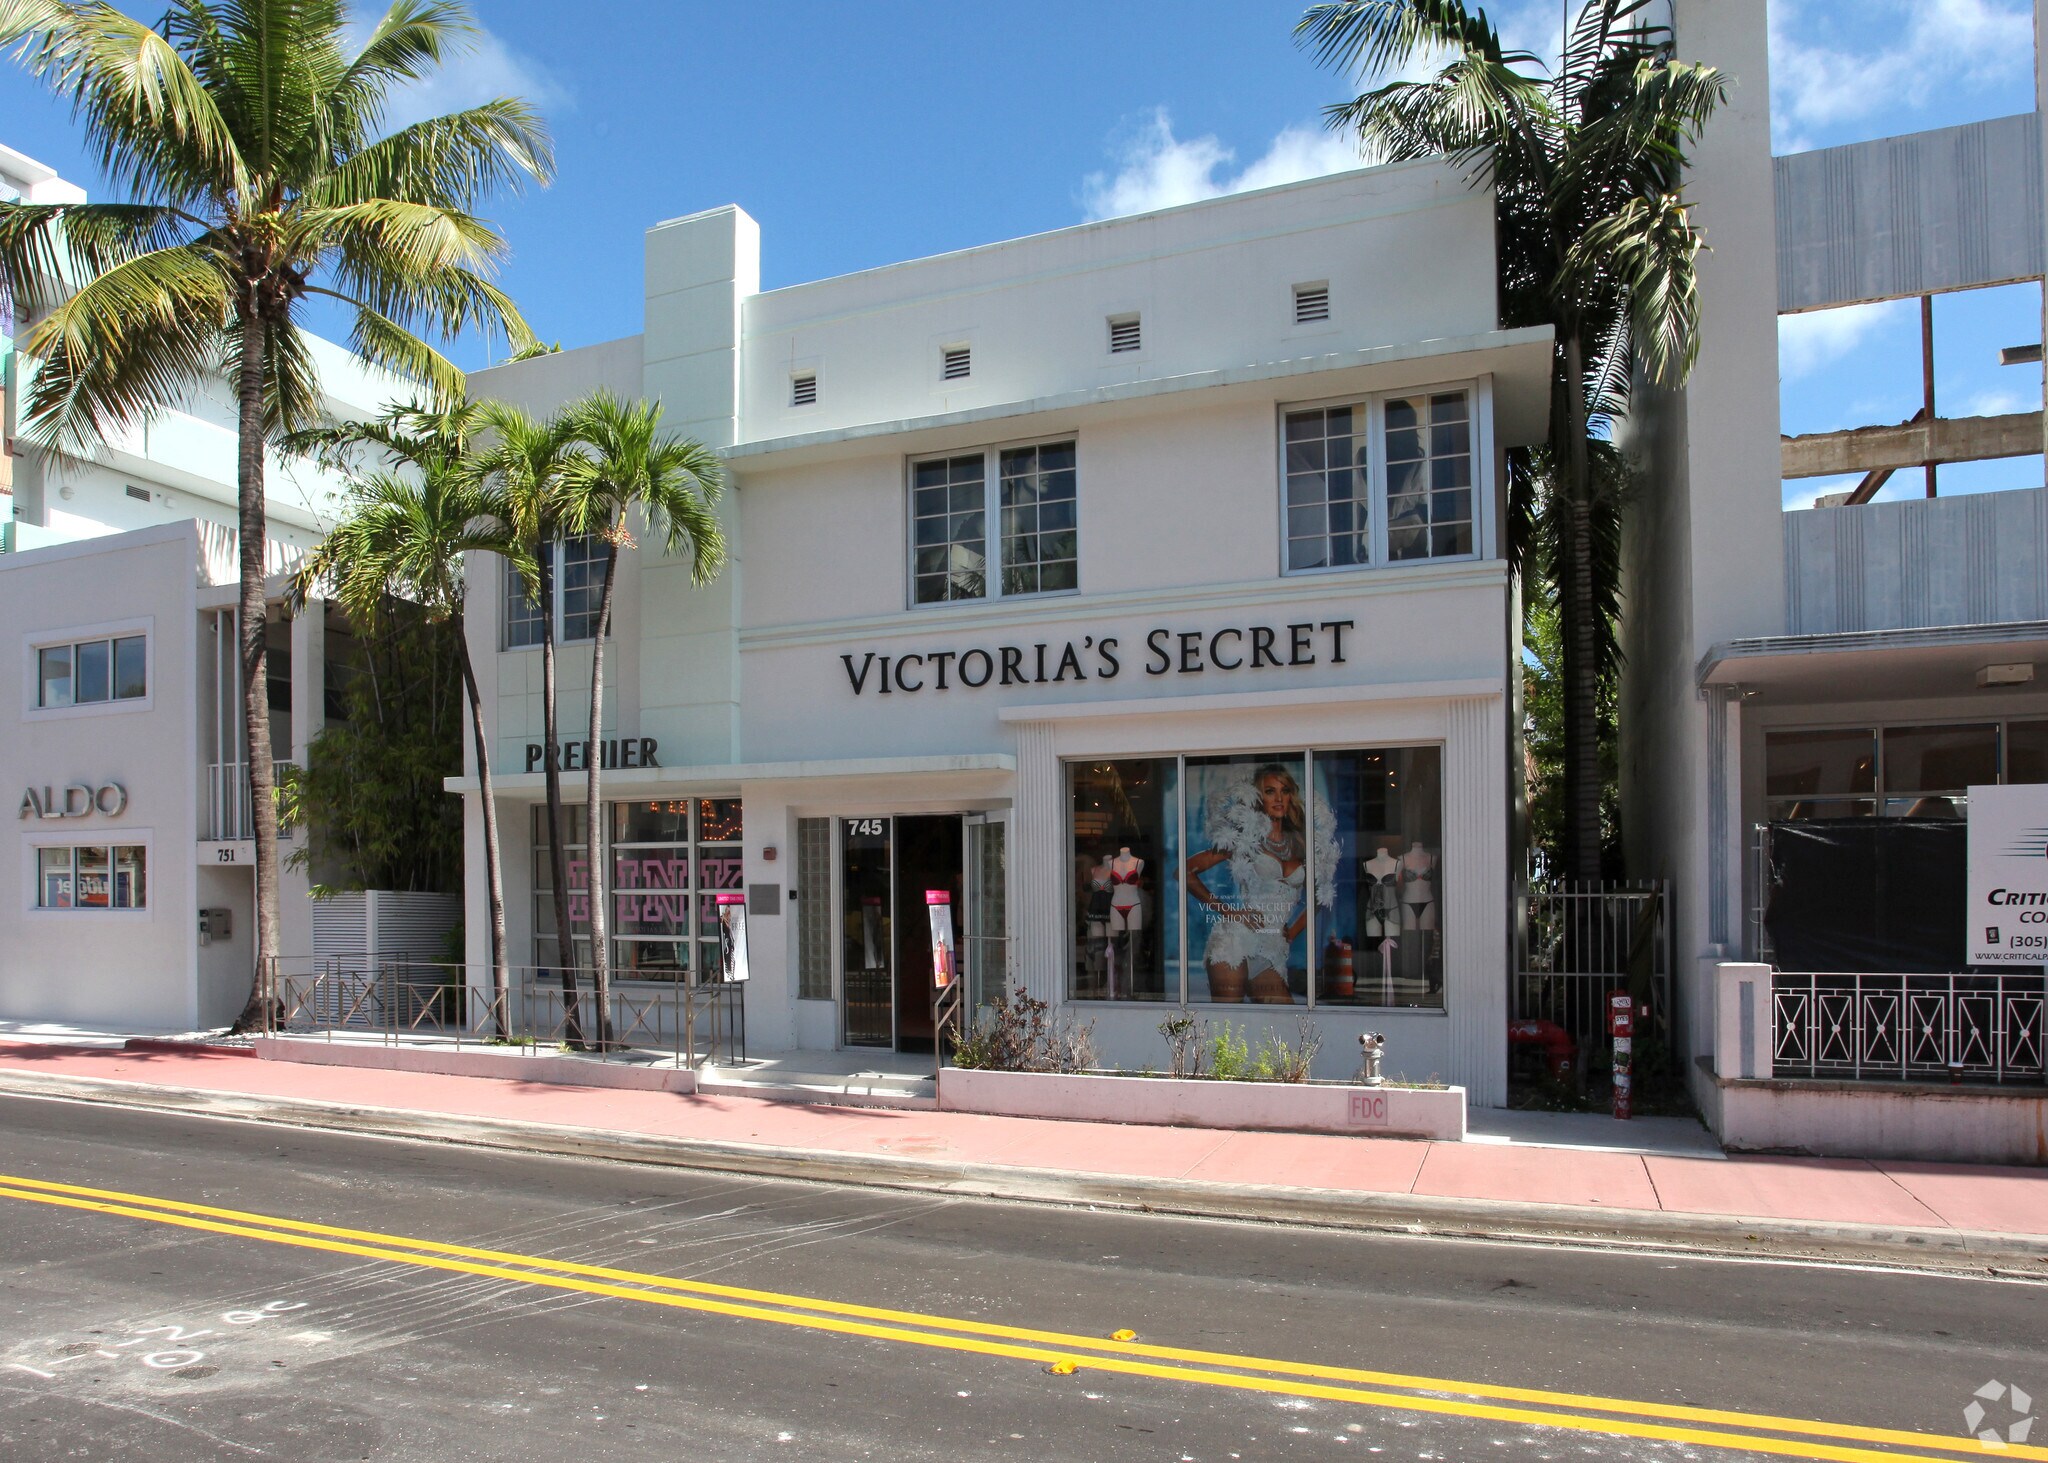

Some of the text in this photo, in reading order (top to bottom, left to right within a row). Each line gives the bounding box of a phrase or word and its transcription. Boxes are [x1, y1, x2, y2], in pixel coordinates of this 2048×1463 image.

[840, 620, 1354, 695] VICTORIA'S SECRET
[18, 782, 128, 820] ALDO
[848, 819, 883, 836] 745
[217, 848, 236, 862] 751
[1987, 888, 2048, 906] CRITI
[1198, 902, 1293, 912] VICTORIA'S SECRET
[1206, 913, 1286, 923] FASHION SHOW
[2019, 911, 2048, 924] CO
[2010, 936, 2048, 949] (305)
[1352, 1097, 1383, 1118] FDC
